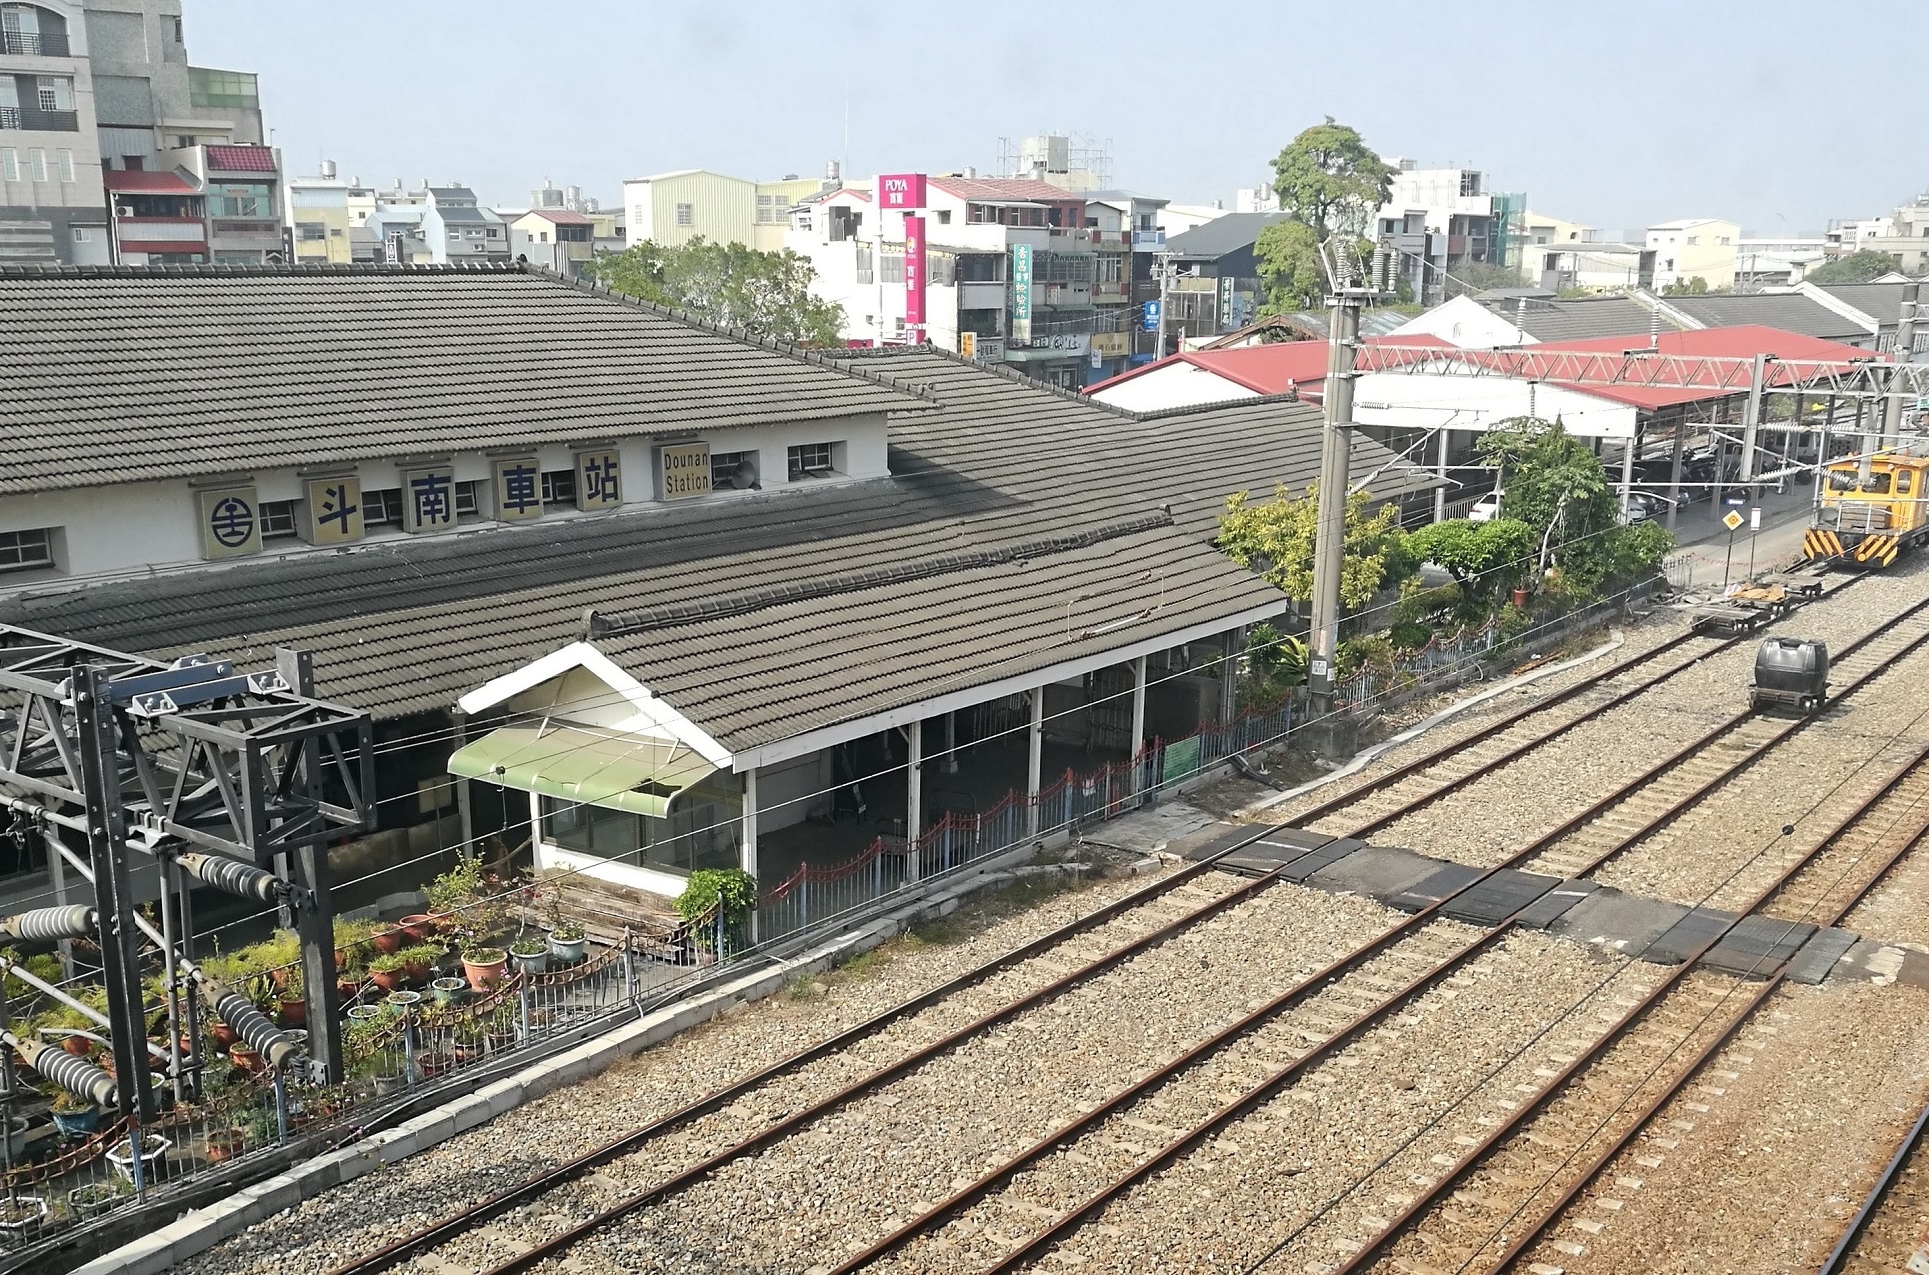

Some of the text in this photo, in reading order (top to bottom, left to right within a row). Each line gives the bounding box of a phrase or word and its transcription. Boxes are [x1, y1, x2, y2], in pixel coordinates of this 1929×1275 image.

[885, 179, 908, 191] POYA
[664, 452, 708, 471] Dounan
[666, 472, 709, 494] Station
[318, 456, 619, 535] 斗南車站
